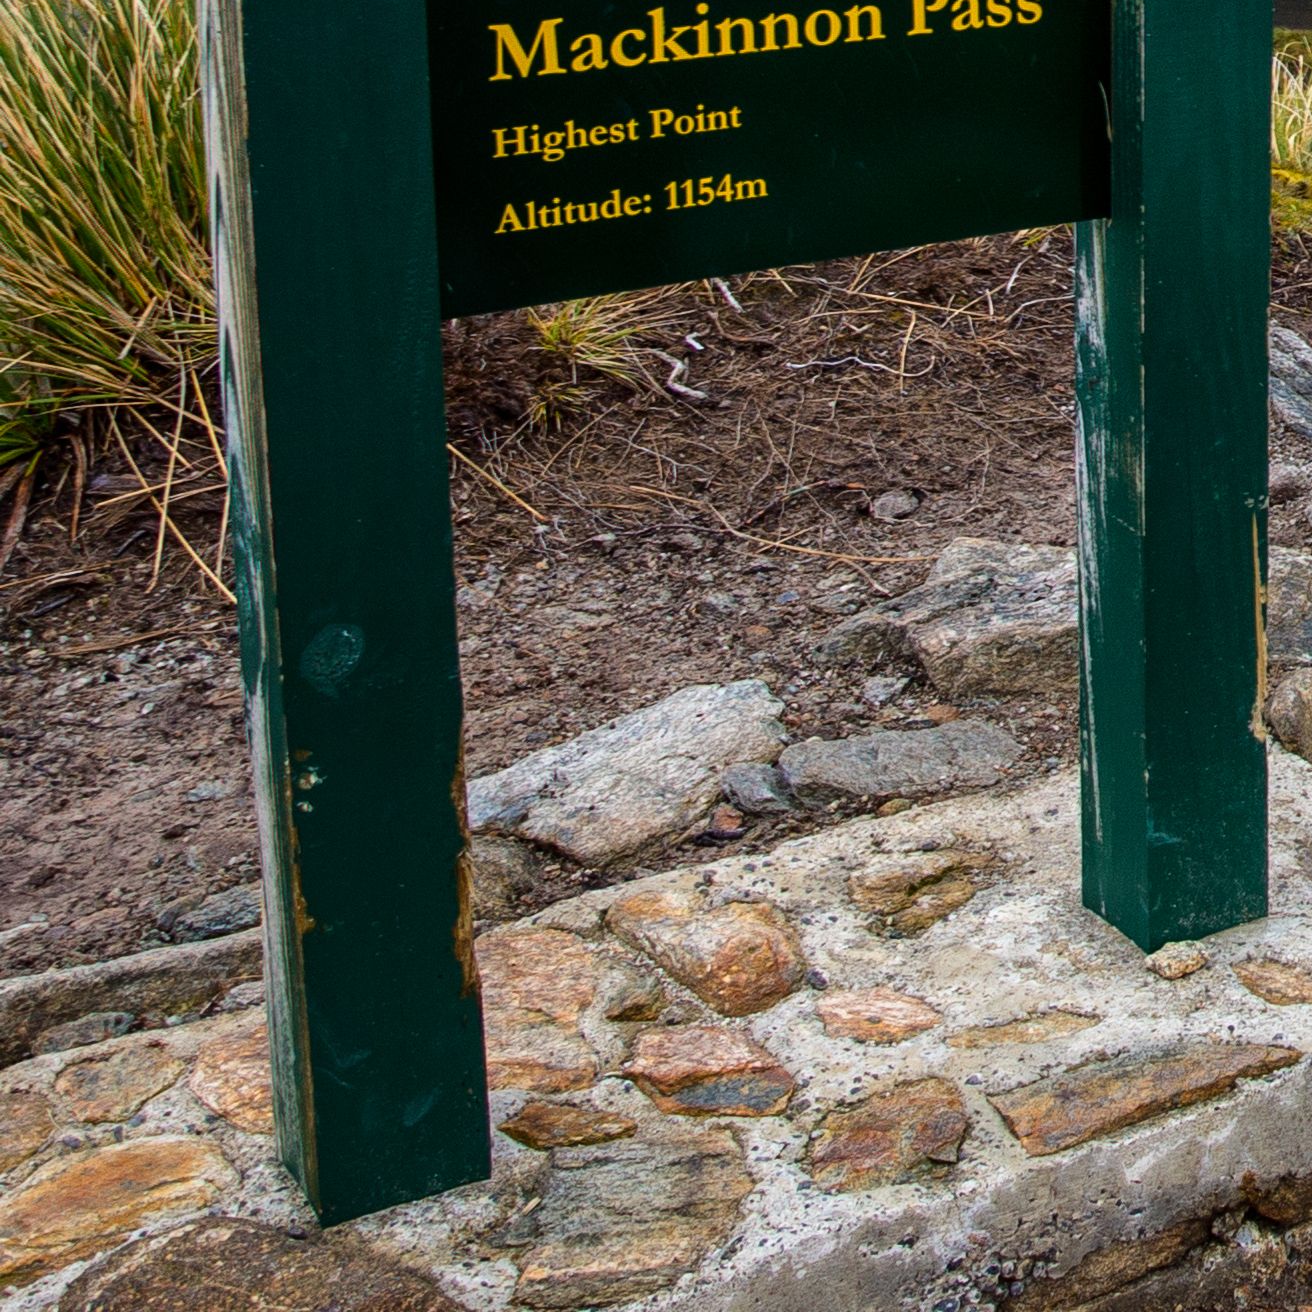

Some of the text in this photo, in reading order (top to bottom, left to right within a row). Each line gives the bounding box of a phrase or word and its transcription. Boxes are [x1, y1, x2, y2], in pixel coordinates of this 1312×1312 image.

[488, 2, 886, 81] Mackinnon
[492, 104, 742, 162] Highest Point
[495, 173, 768, 234] Altitude: 1154m
